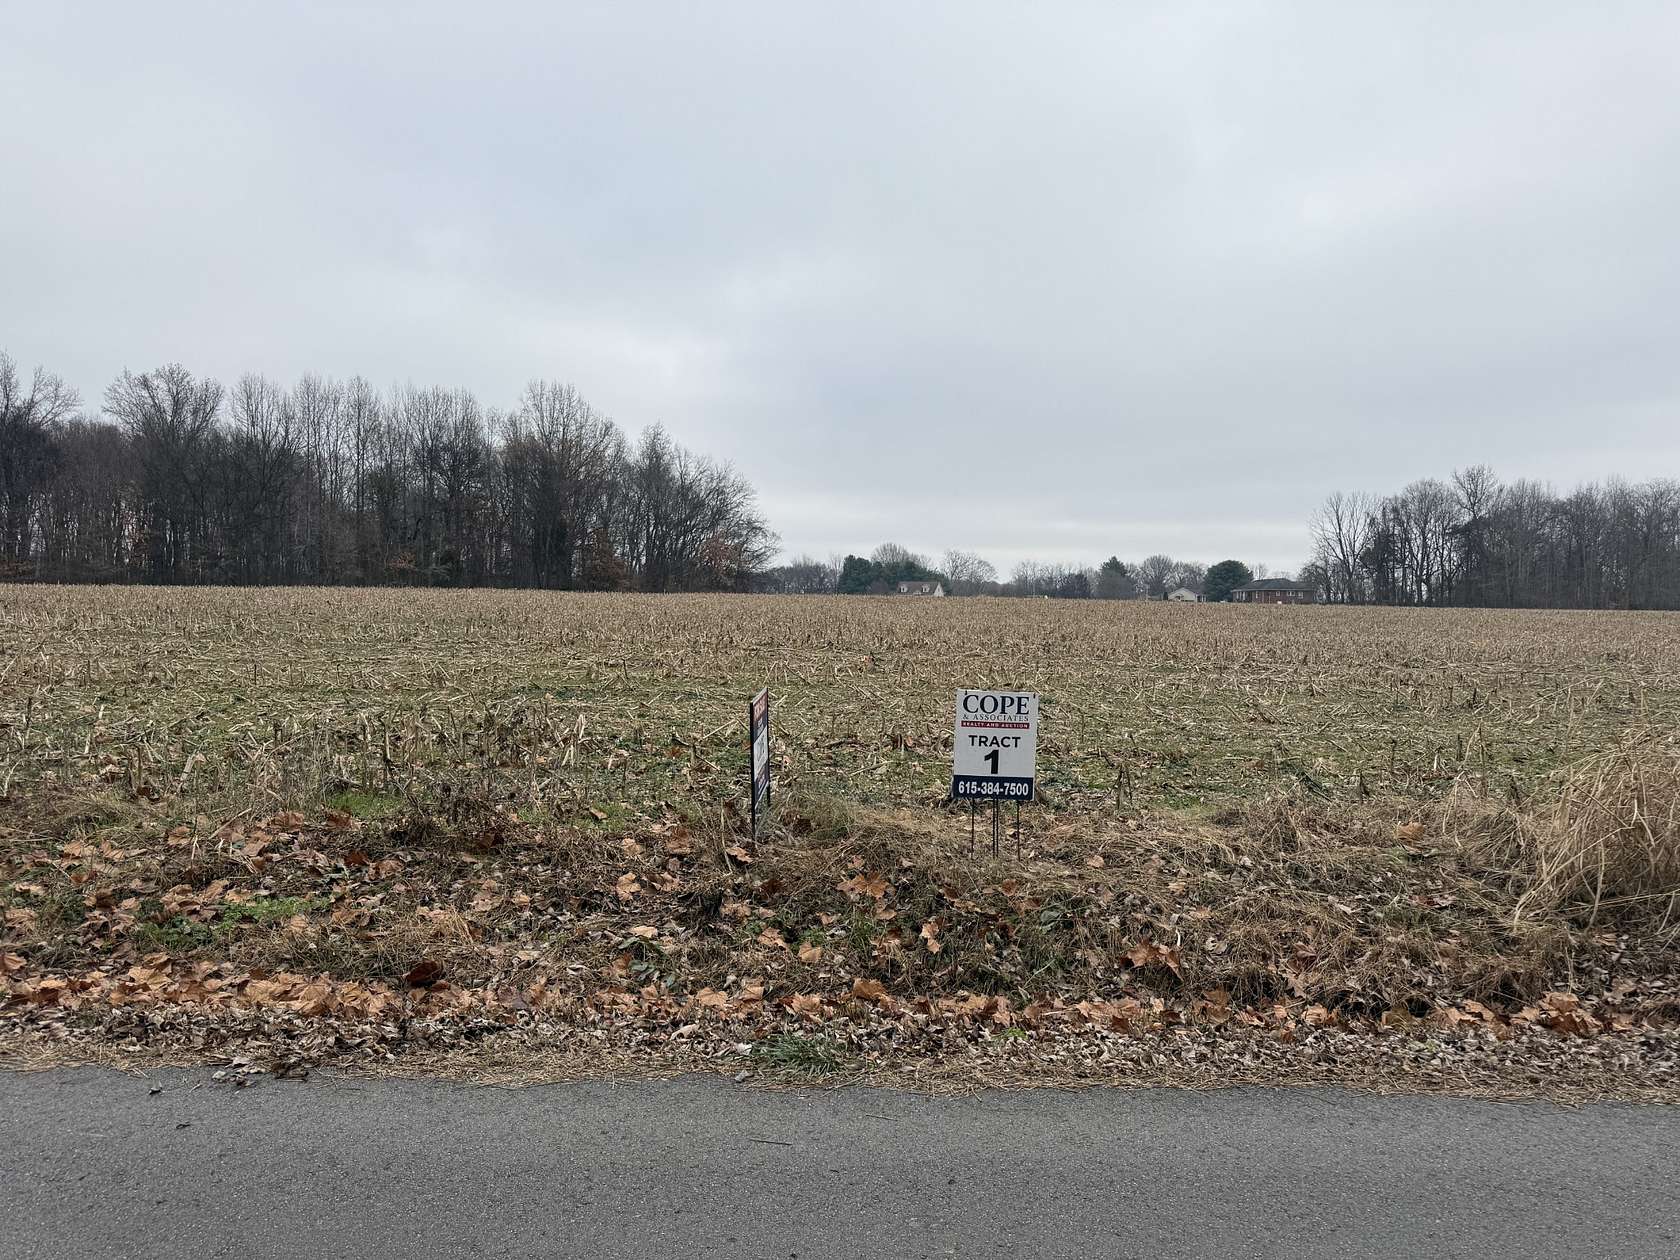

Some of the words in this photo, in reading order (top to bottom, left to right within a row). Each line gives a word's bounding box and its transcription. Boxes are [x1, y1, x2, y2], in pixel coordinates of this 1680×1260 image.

[963, 694, 1030, 715] COPE
[973, 714, 1029, 722] ASSOCIATES
[968, 735, 1021, 748] TRACT
[984, 749, 1000, 775] 1
[958, 781, 1029, 796] 615-384-7500
